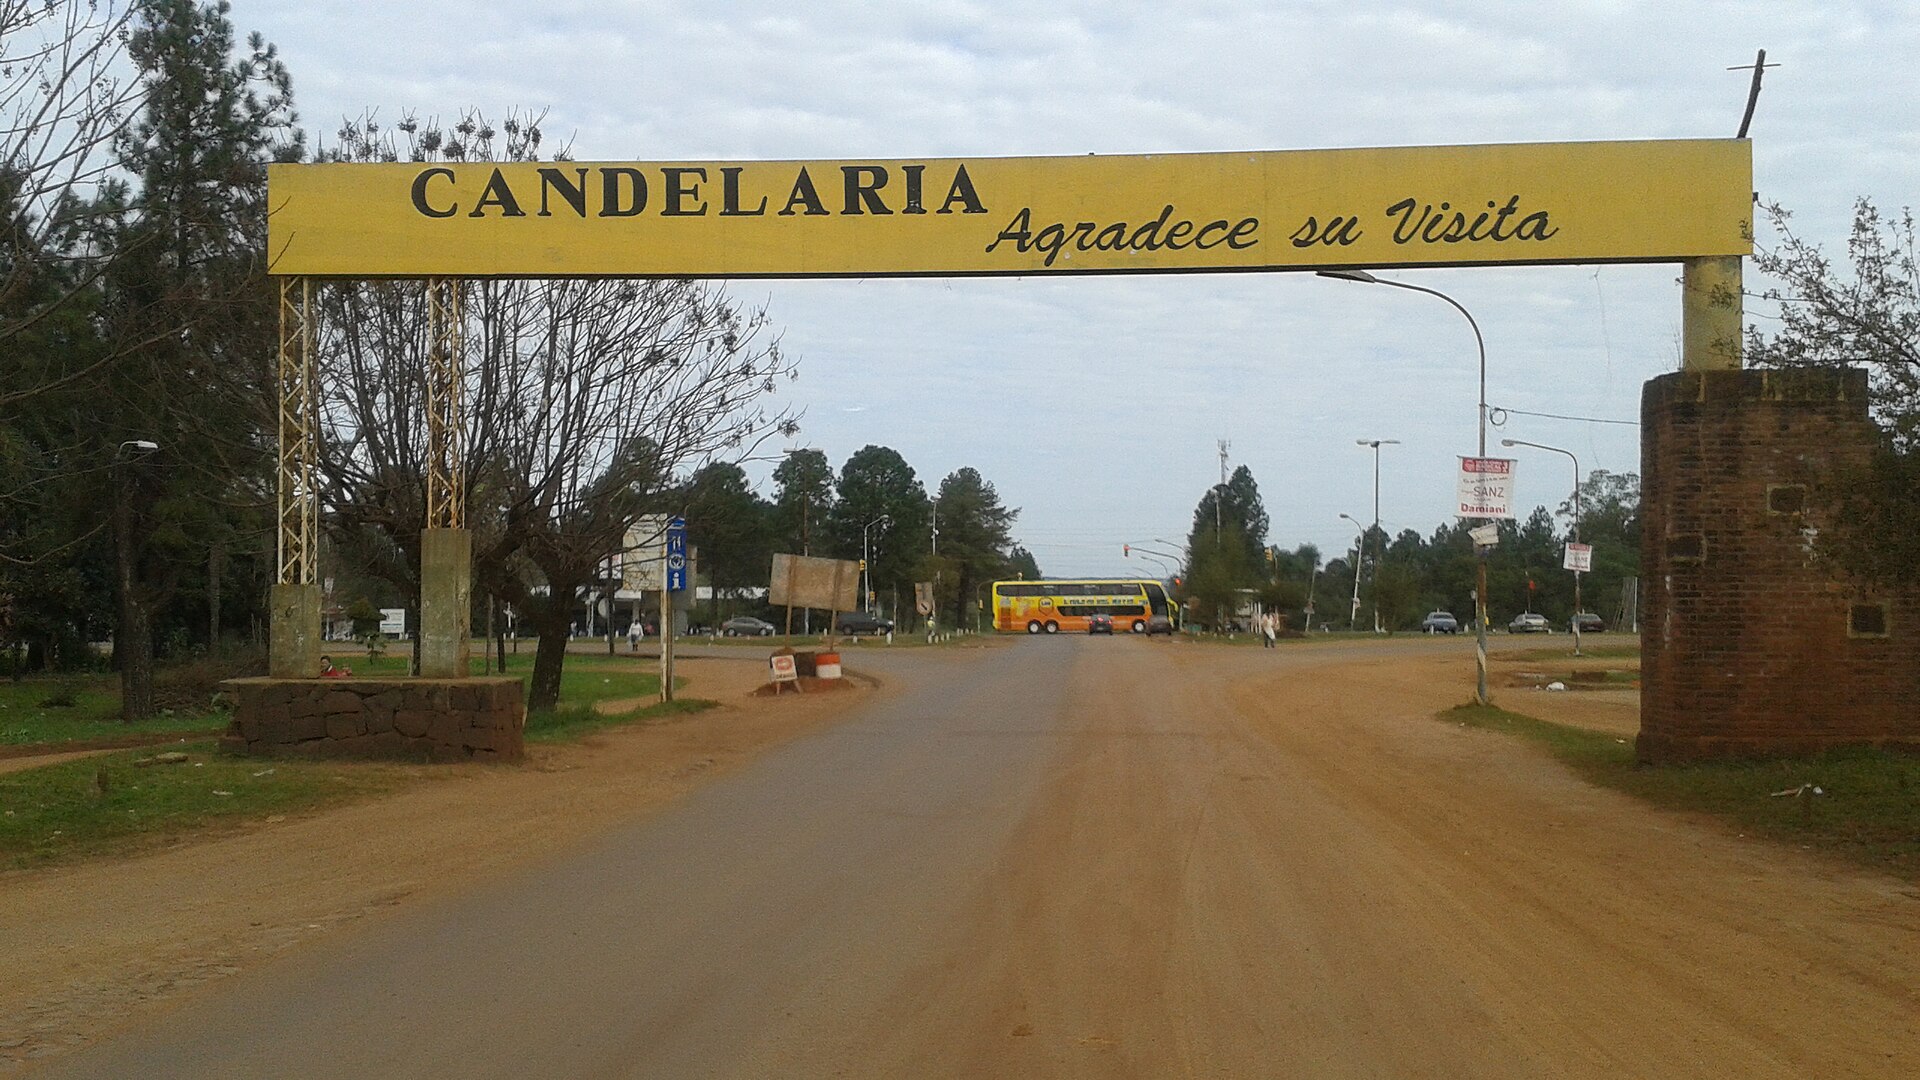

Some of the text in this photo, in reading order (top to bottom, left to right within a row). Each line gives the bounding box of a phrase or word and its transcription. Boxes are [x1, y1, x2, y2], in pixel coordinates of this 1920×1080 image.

[411, 163, 988, 219] CANDELARIA
[986, 194, 1560, 267] Agradece su Visita
[1461, 502, 1506, 513] Damiani
[1473, 486, 1504, 498] SANZ
